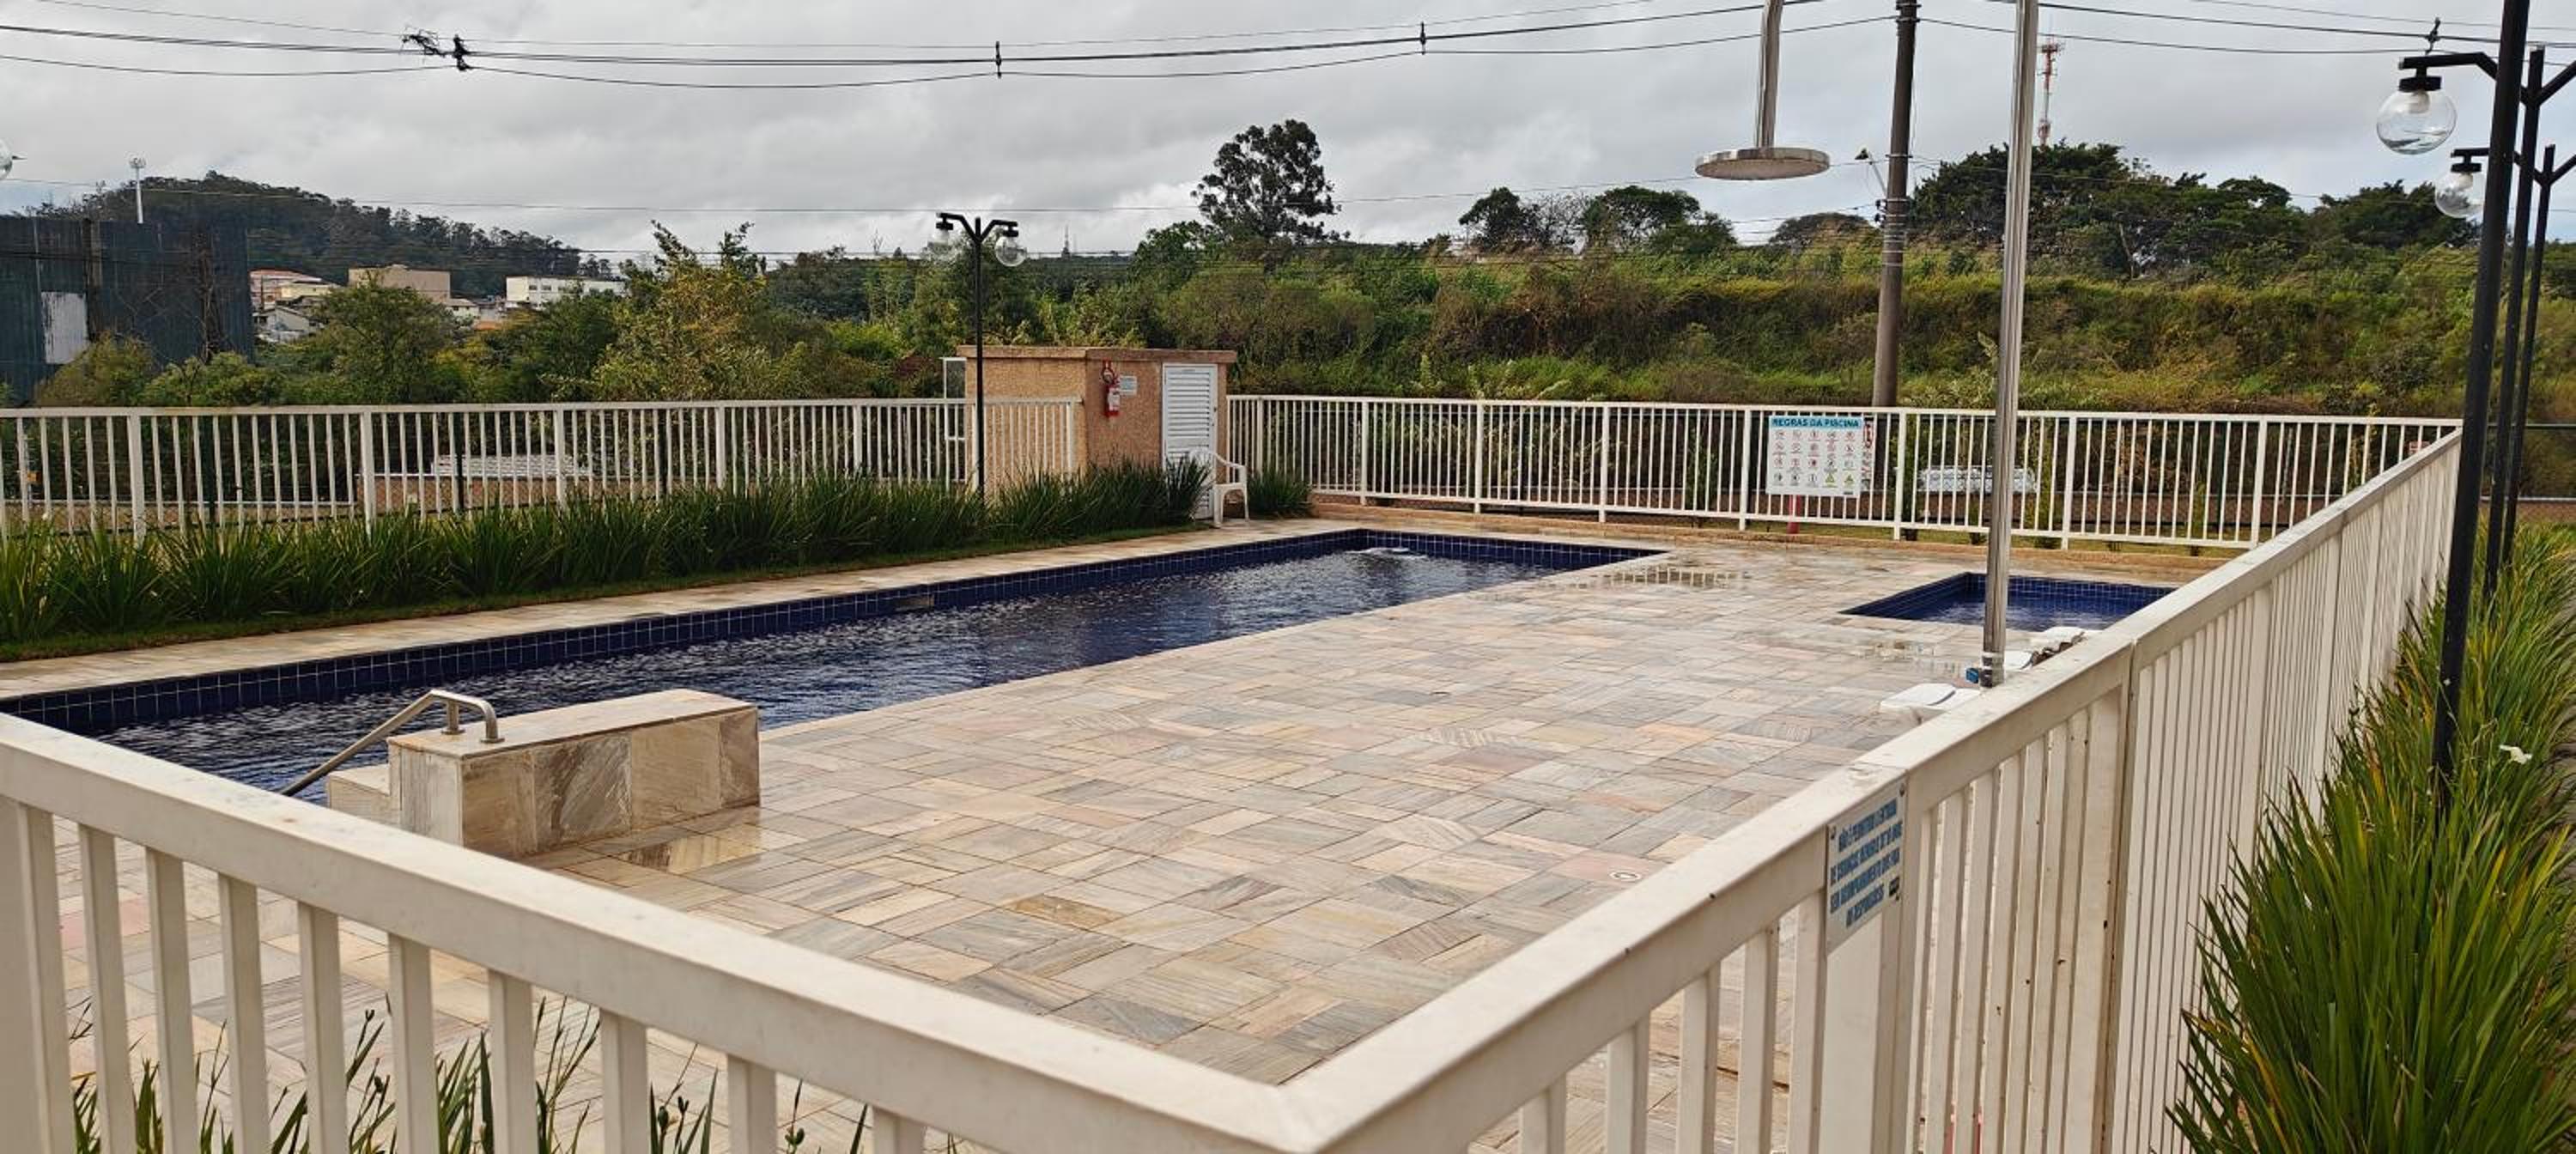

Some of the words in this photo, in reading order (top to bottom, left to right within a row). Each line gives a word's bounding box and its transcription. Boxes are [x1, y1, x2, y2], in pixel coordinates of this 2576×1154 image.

[1772, 418, 1807, 427] REGRAS
[1810, 418, 1822, 427] DA
[1825, 418, 1859, 428] PISCINA
